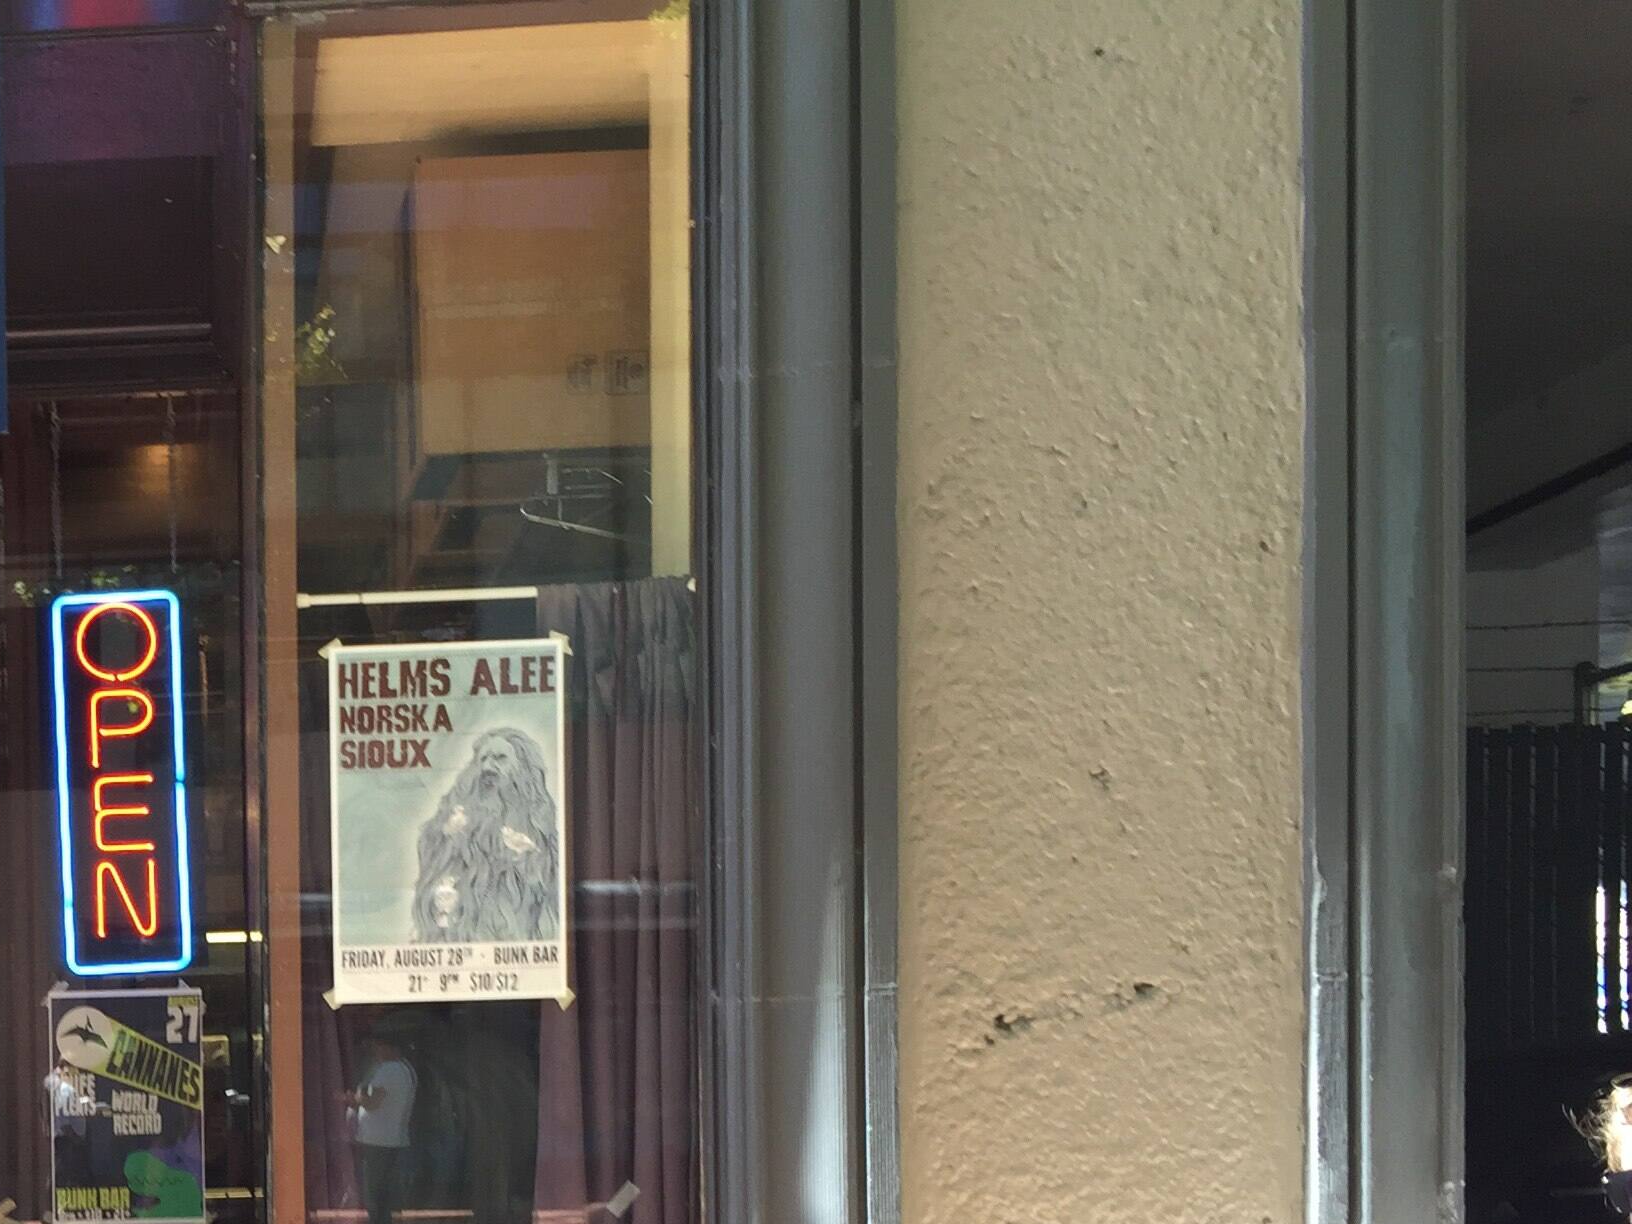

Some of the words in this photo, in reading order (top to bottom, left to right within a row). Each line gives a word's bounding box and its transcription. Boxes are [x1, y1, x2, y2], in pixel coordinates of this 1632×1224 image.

[337, 656, 452, 700] HELMS
[470, 655, 556, 696] ALEE
[339, 703, 453, 735] NORSKA
[76, 601, 157, 938] OPEN
[340, 739, 432, 770] SIOUX
[342, 950, 390, 969] FRIDAY,
[394, 949, 443, 968] AUGUST
[493, 947, 529, 965] BUNK
[533, 946, 559, 964] BAR
[166, 1004, 199, 1044] 27
[112, 1089, 159, 1113] WORLD
[113, 1112, 162, 1136] RECORD
